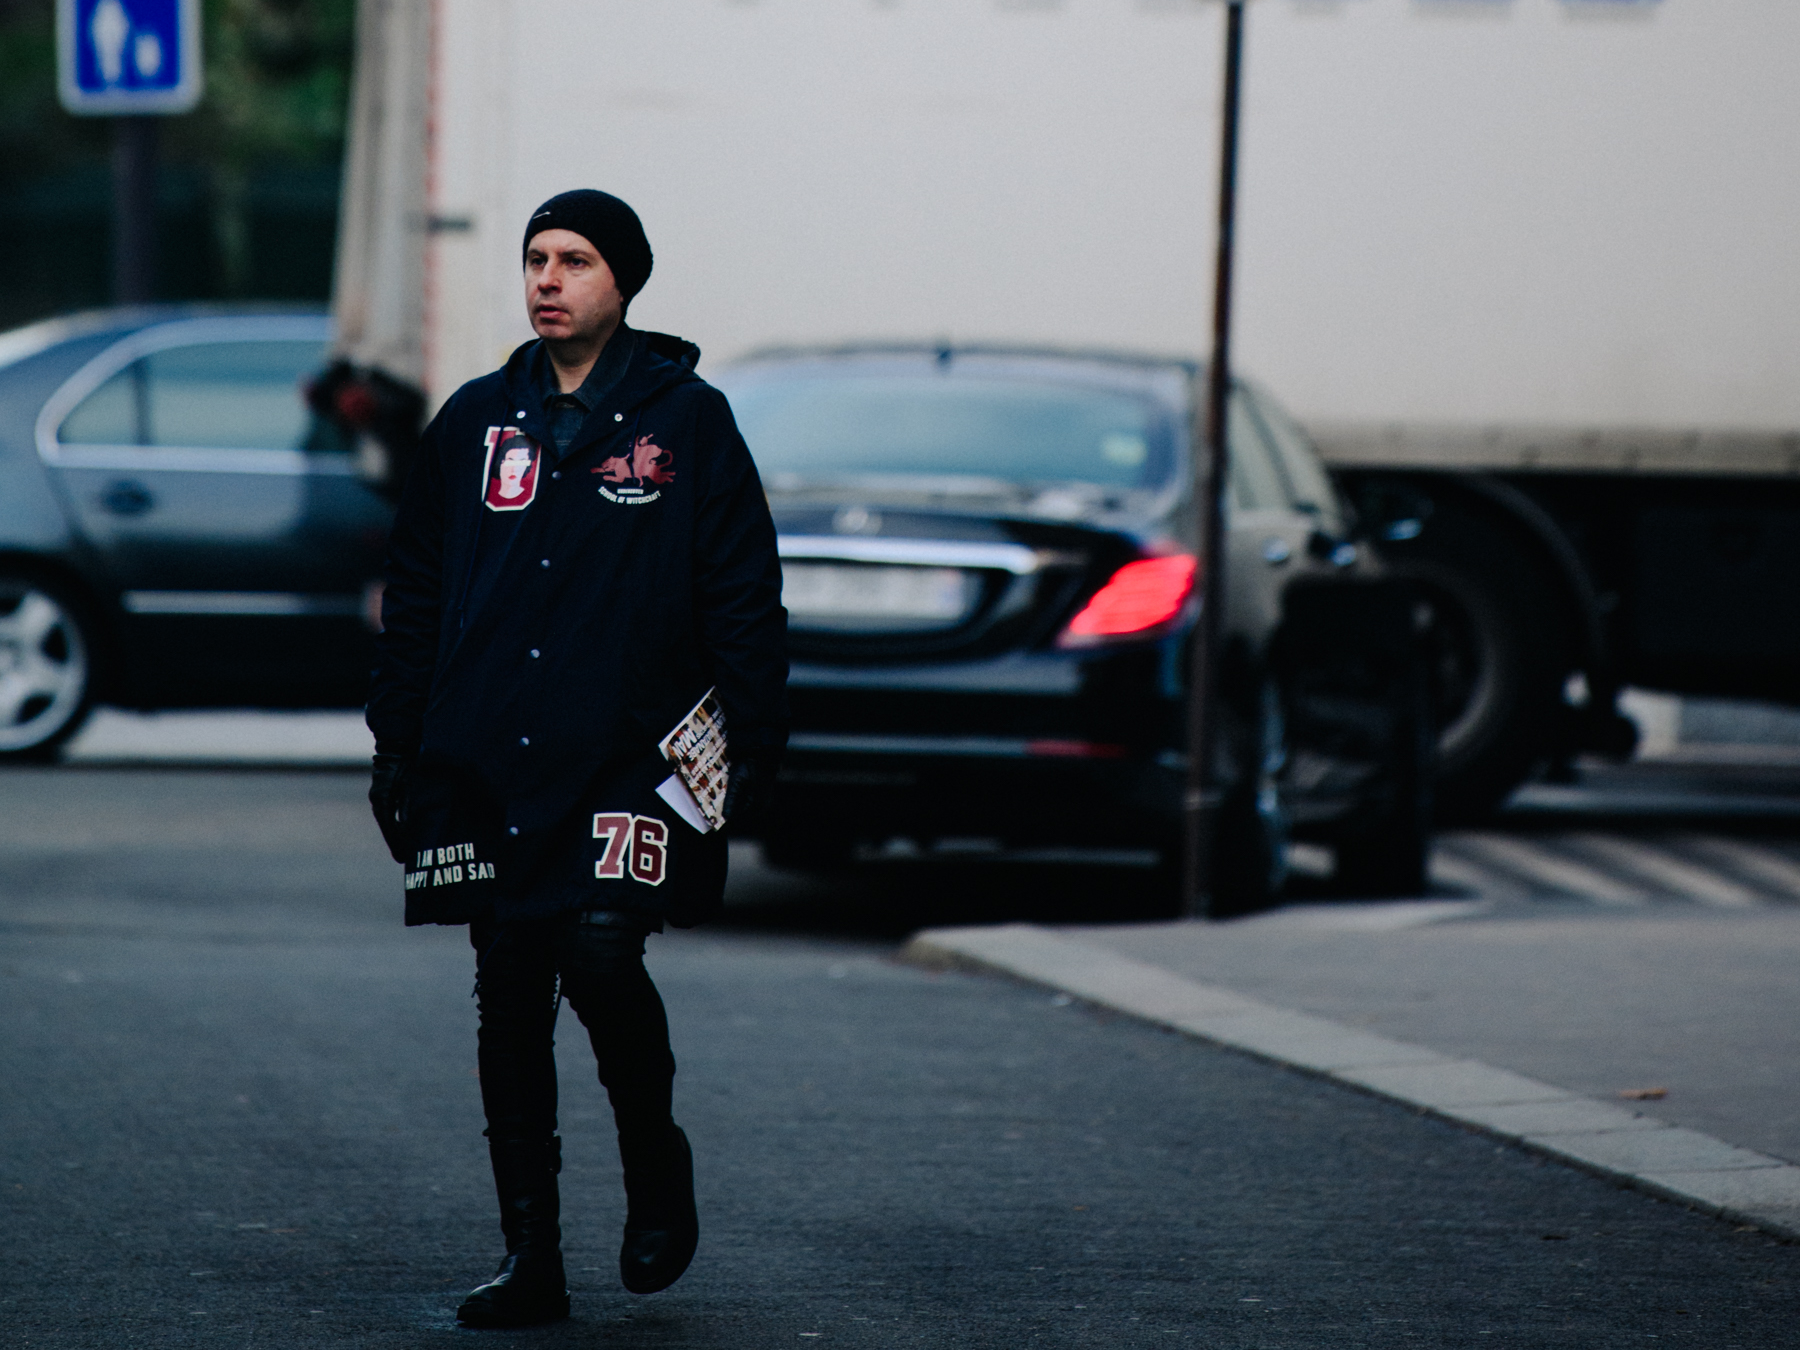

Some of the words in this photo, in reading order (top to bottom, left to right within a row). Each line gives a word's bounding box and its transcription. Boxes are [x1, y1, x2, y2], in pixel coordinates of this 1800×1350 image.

[416, 851, 421, 868] I
[436, 842, 475, 865] BOTH
[592, 812, 669, 887] 76
[433, 865, 463, 886] AND
[467, 862, 496, 881] SAD
